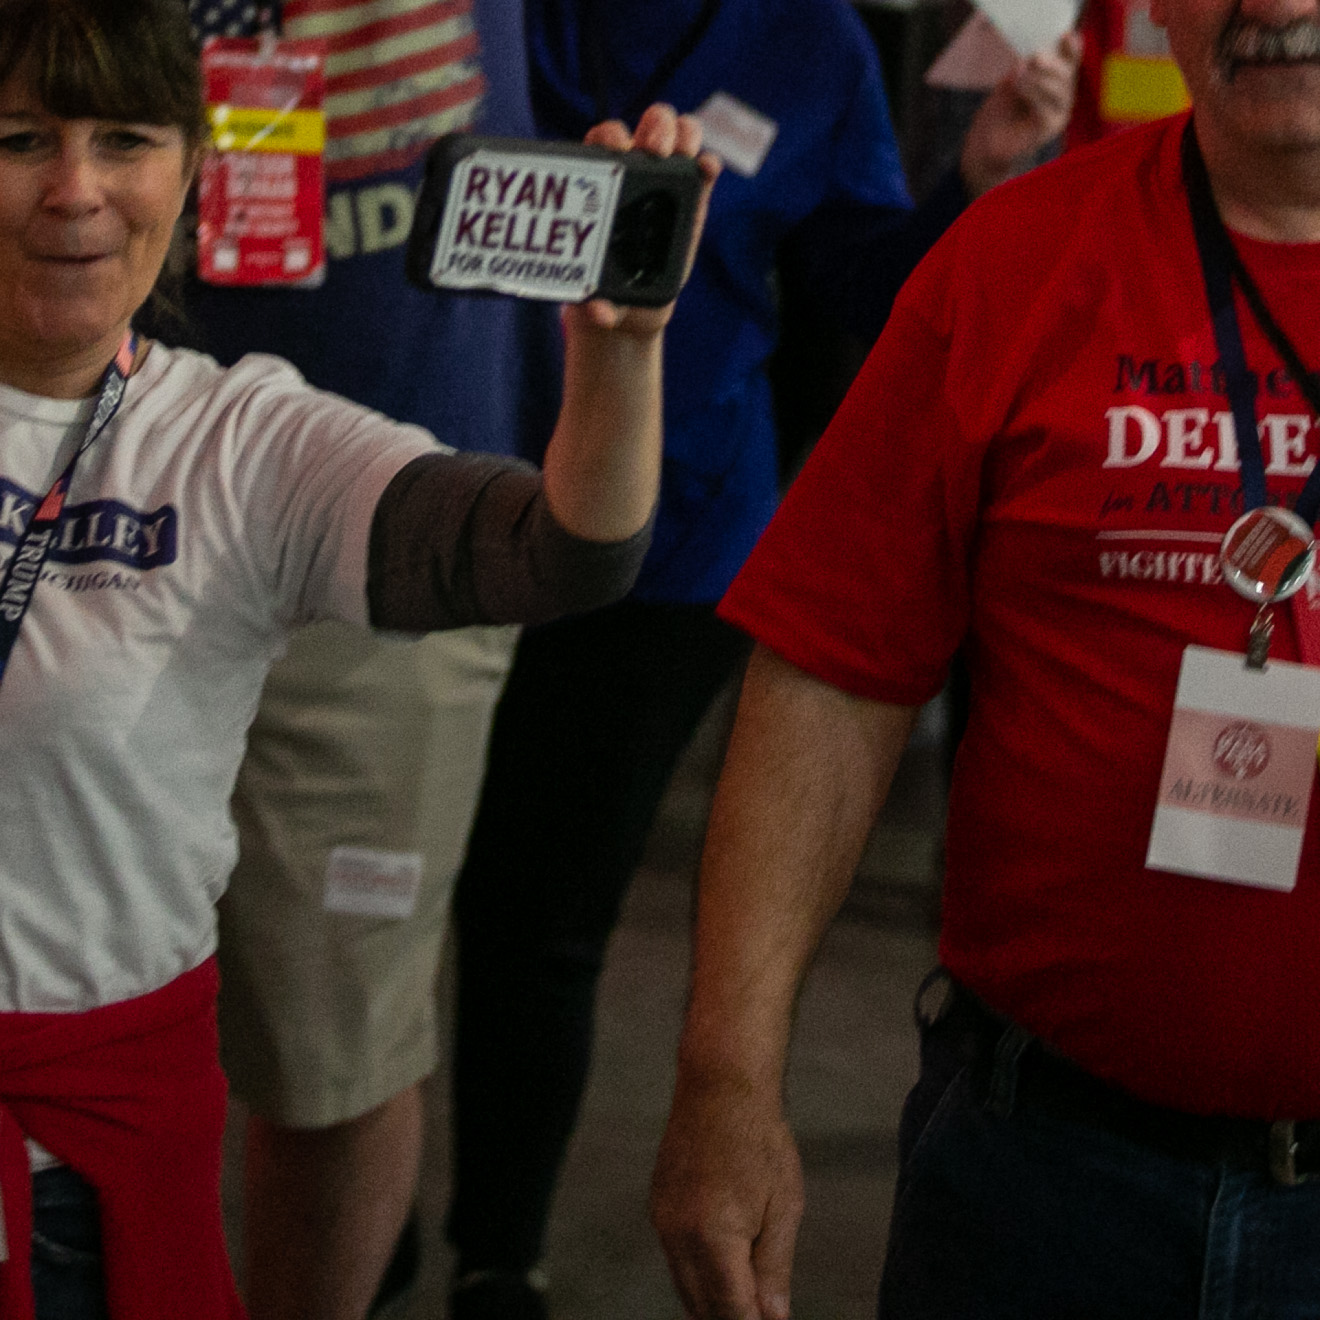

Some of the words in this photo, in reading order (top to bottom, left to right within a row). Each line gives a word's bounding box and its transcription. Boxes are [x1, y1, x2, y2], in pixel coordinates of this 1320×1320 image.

[463, 165, 570, 212] RYAN
[454, 208, 597, 259] KELLEY
[447, 253, 485, 274] FOR
[487, 256, 588, 281] GOVERNOR
